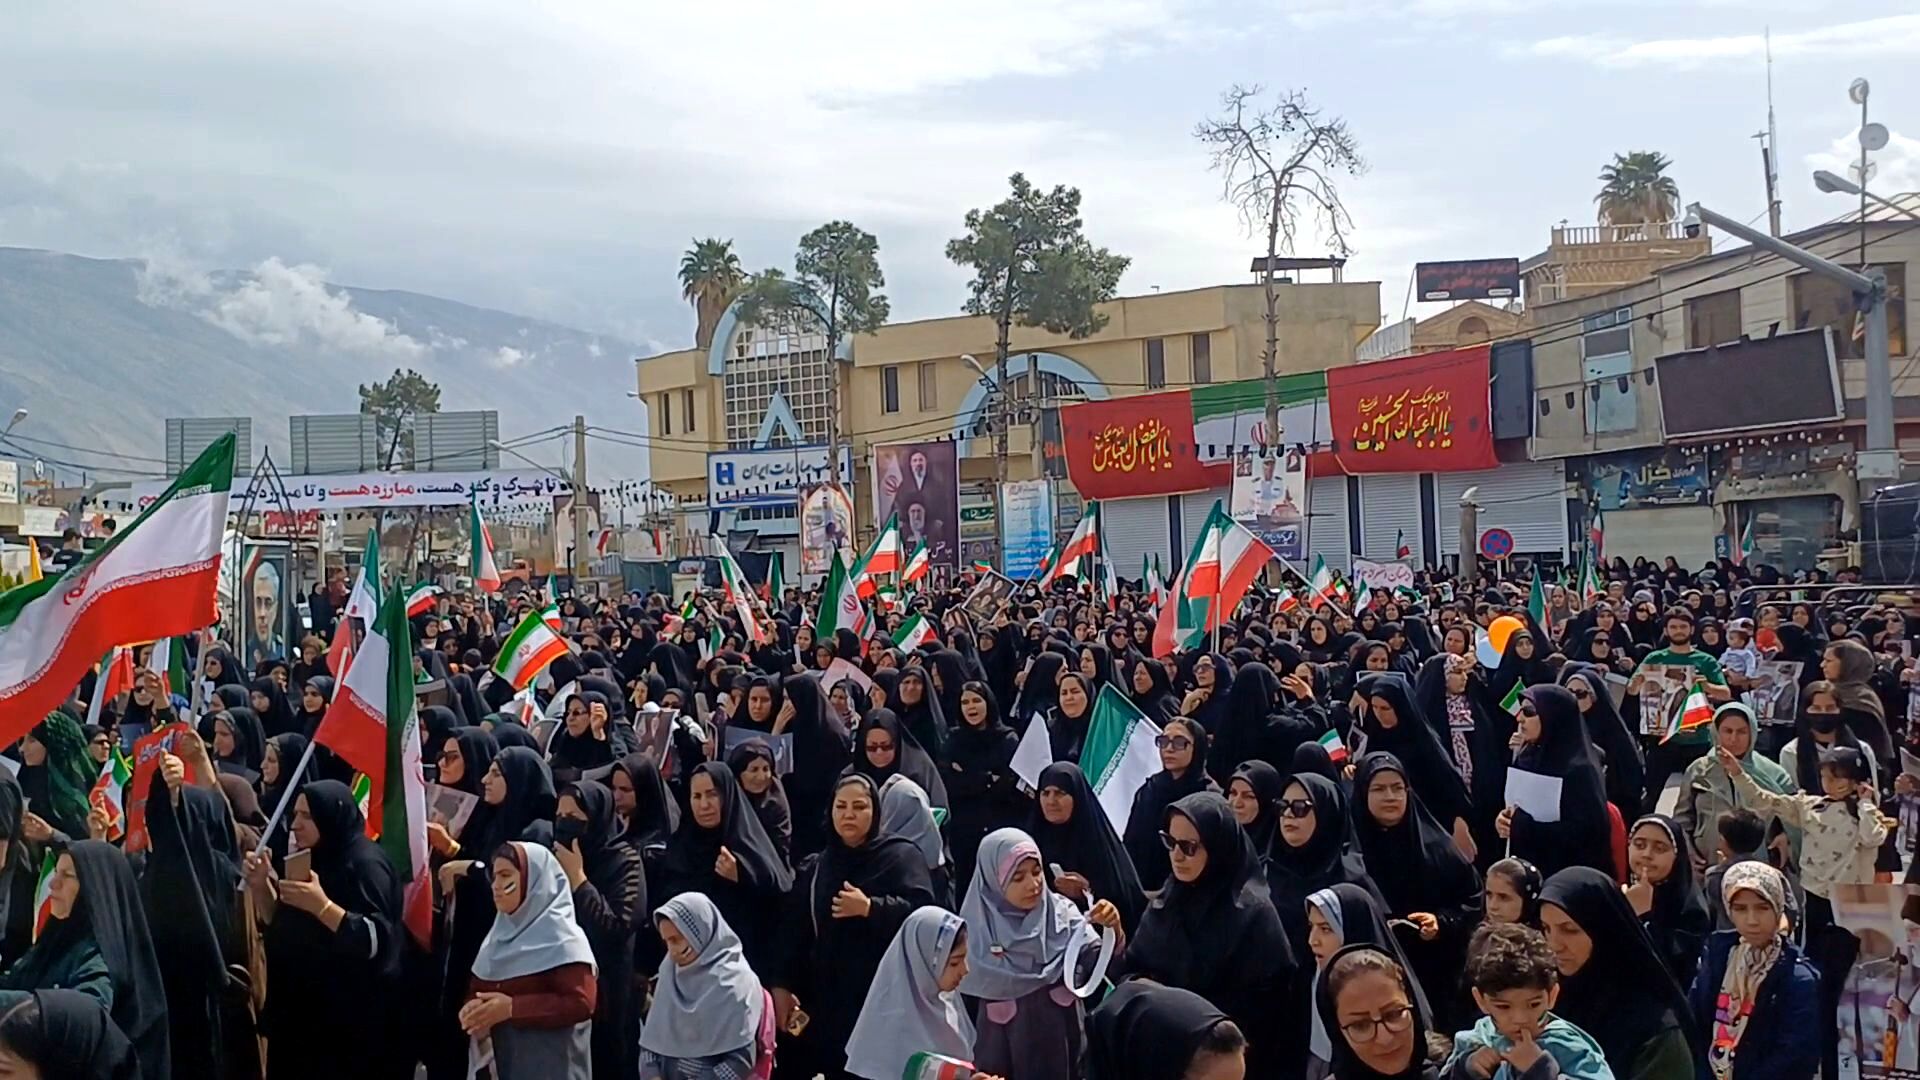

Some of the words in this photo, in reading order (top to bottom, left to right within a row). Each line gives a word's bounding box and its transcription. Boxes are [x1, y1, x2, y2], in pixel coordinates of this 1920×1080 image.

[303, 483, 317, 497] تا
[317, 486, 327, 502] و
[328, 484, 370, 496] هست
[502, 476, 543, 497] شرک
